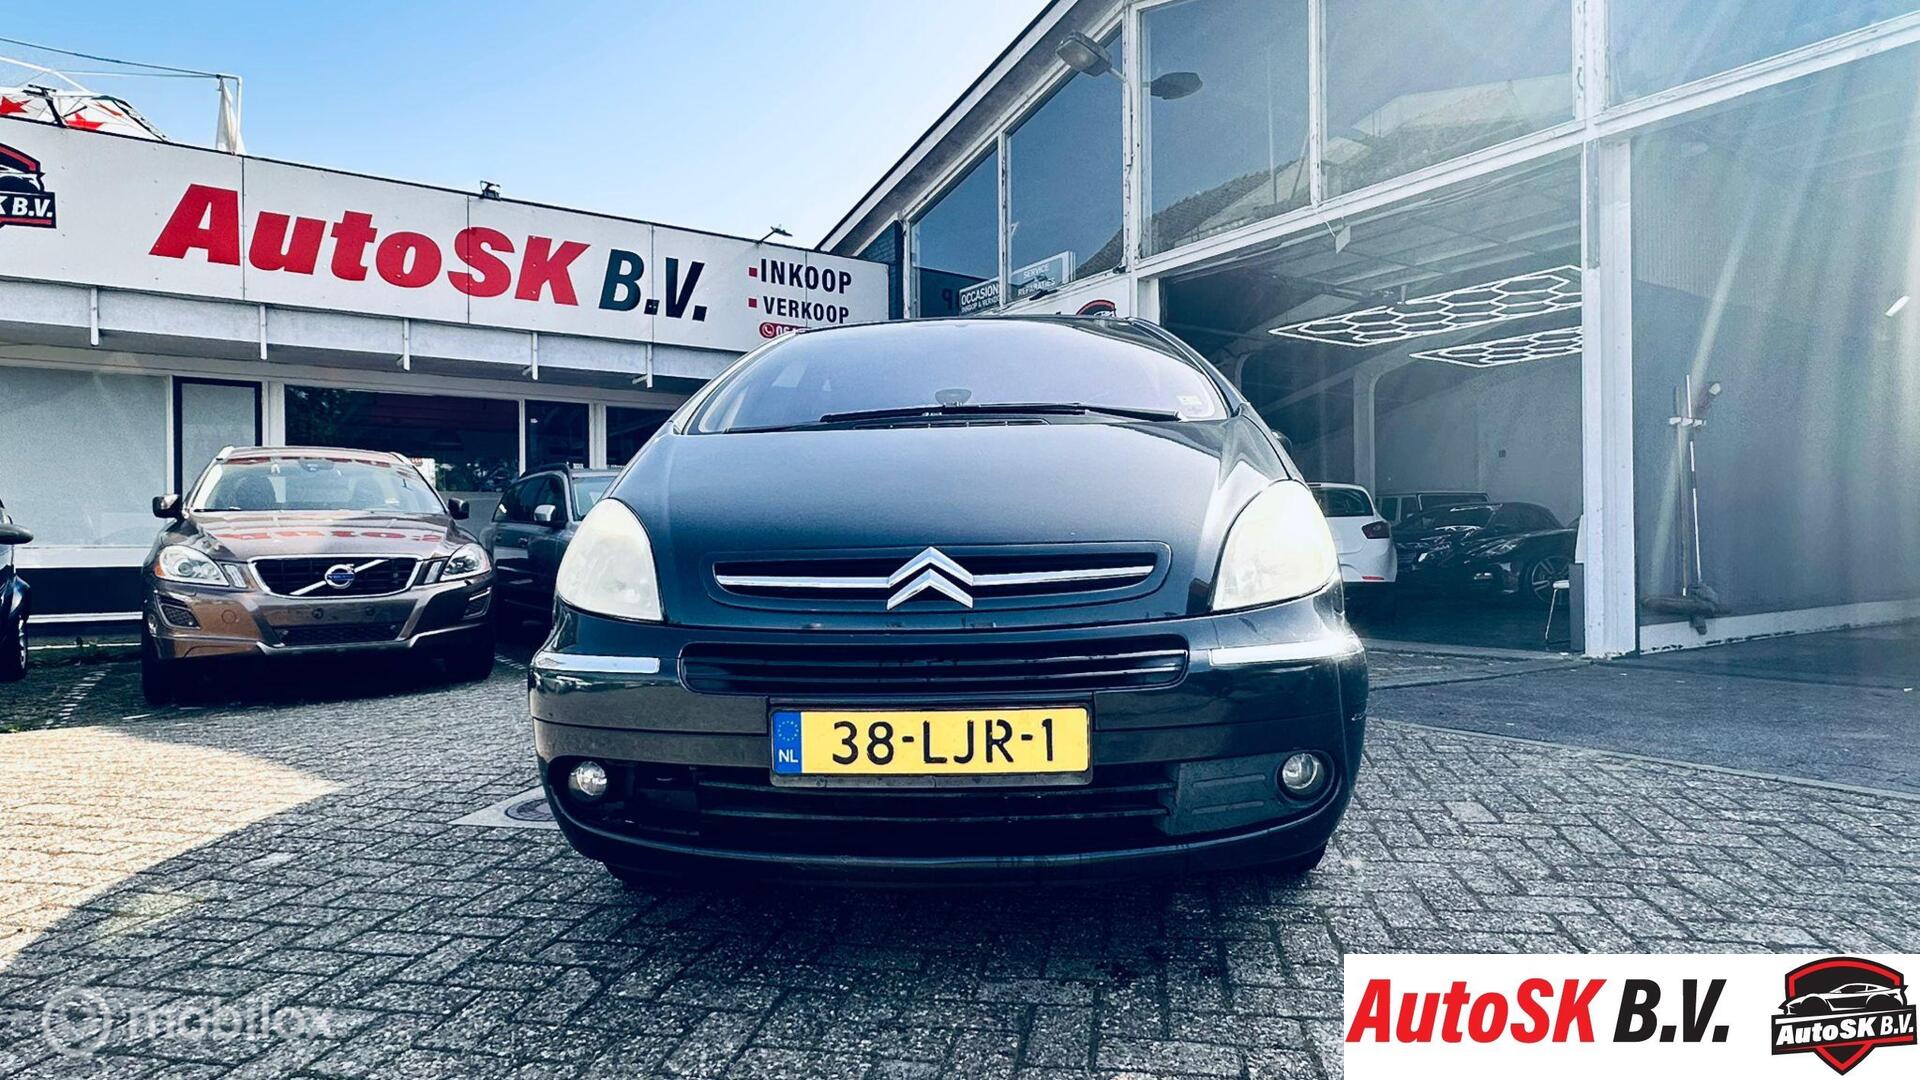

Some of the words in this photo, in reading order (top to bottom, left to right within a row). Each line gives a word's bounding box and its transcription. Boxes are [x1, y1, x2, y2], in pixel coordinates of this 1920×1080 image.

[12, 197, 53, 217] B.V.
[149, 184, 590, 306] AutoSK
[598, 249, 707, 322] B.V.
[760, 258, 852, 294] INKOOP
[1023, 263, 1050, 279] SERVICE
[763, 295, 849, 324] VERKOOP
[778, 748, 799, 763] NL
[832, 718, 1054, 766] 38-LJR-1
